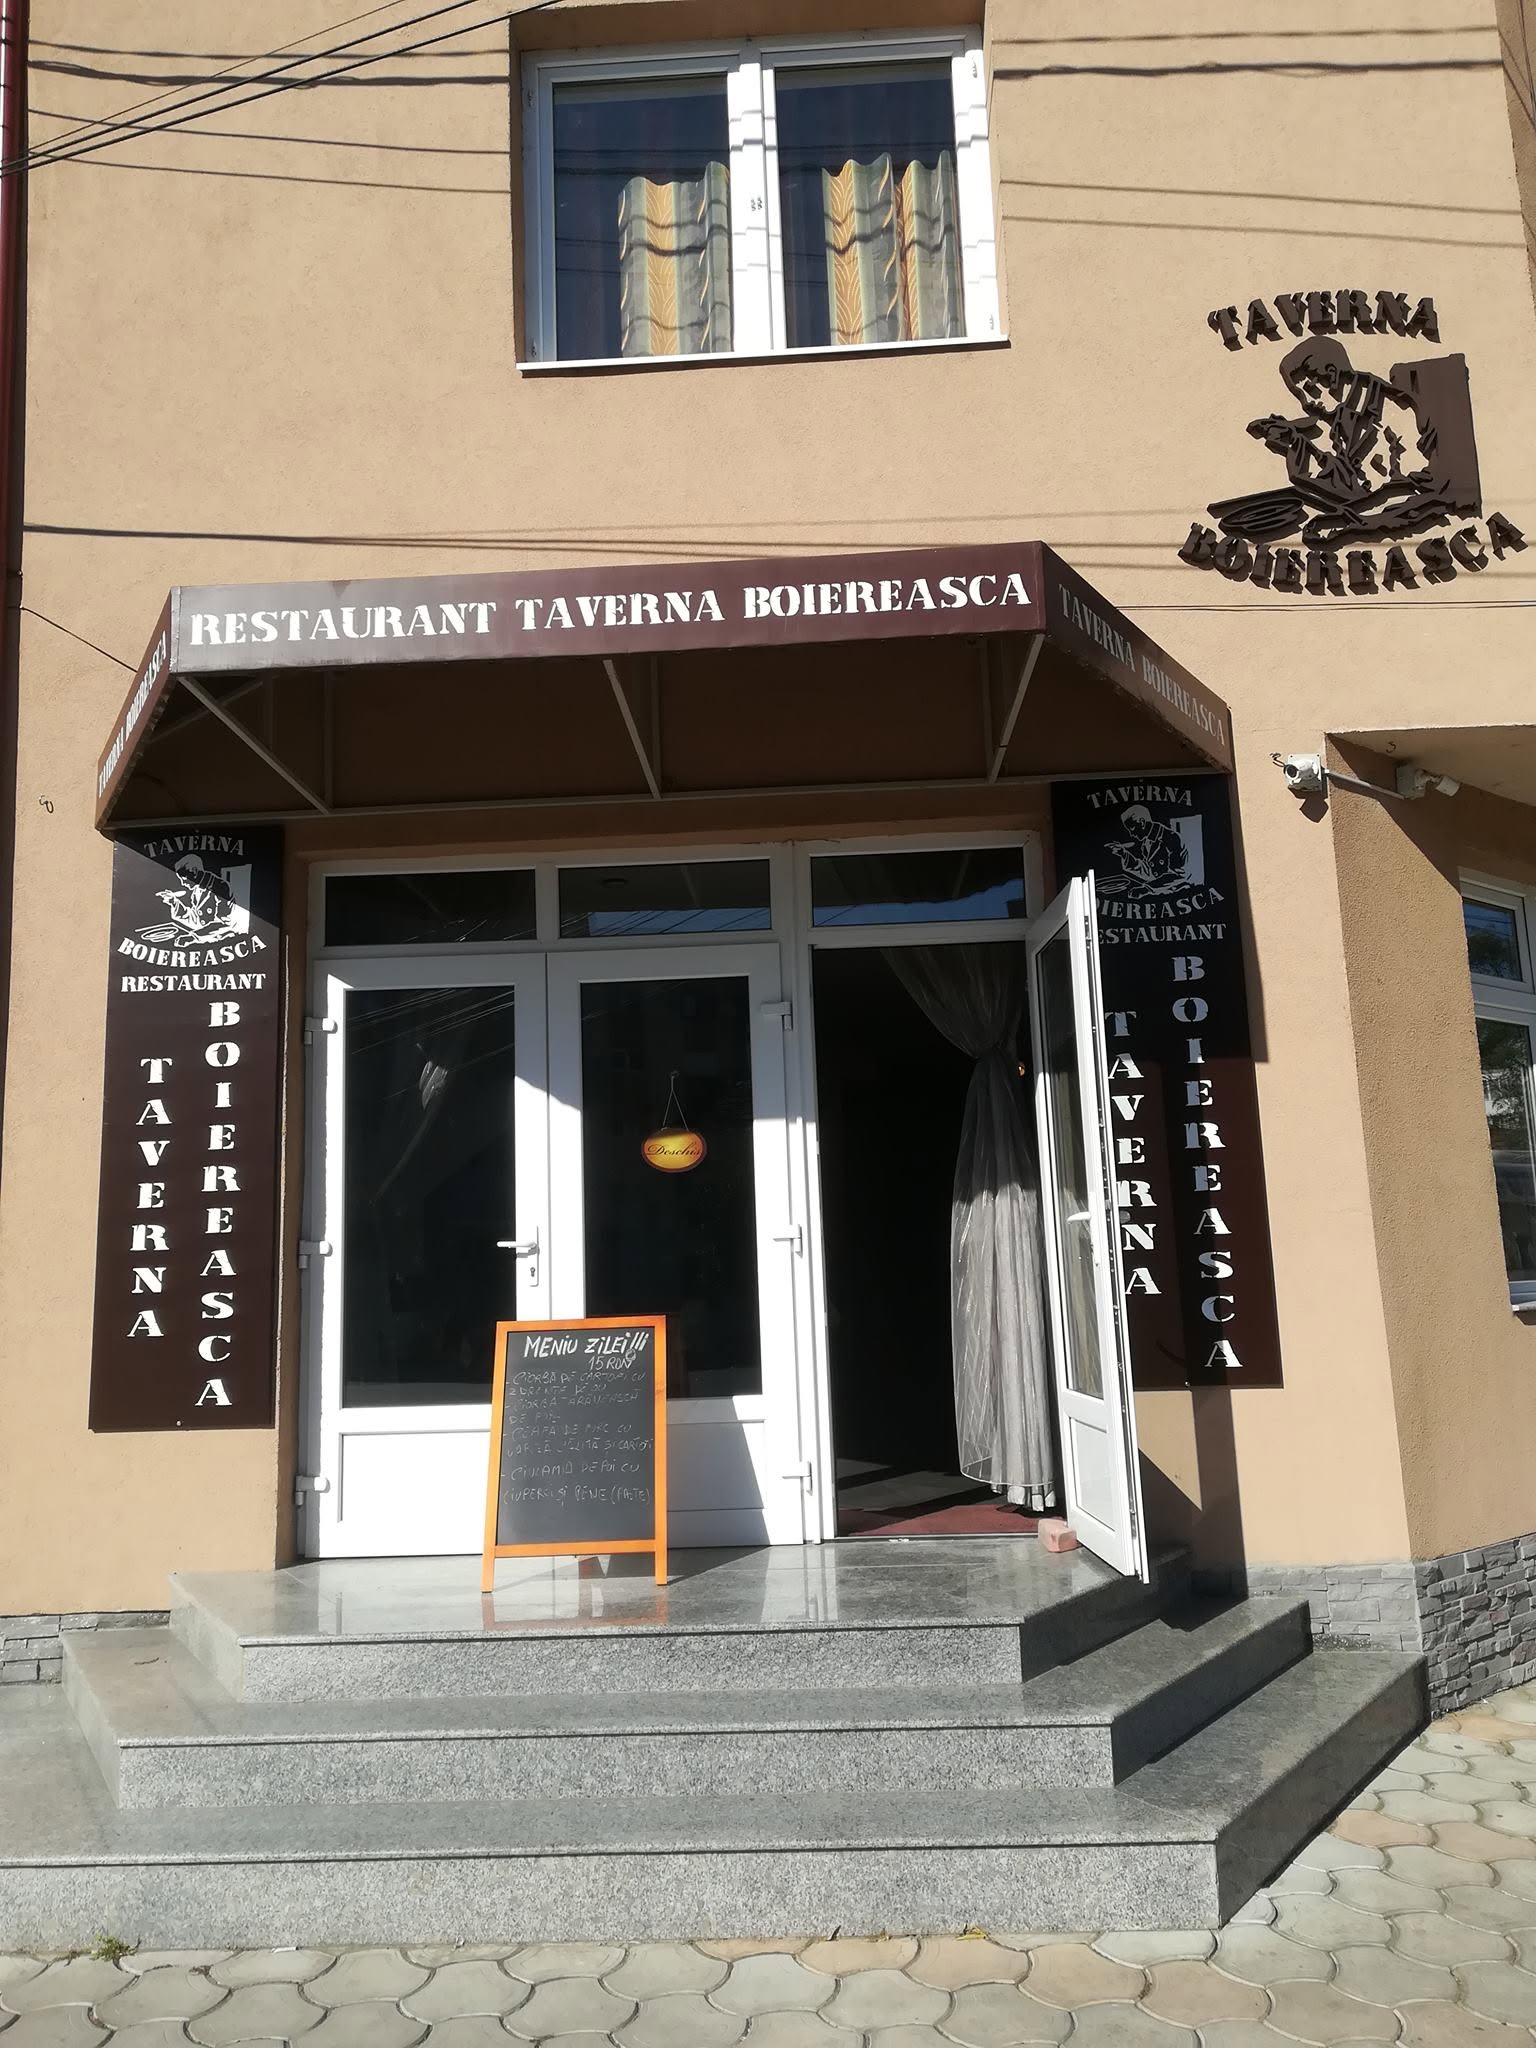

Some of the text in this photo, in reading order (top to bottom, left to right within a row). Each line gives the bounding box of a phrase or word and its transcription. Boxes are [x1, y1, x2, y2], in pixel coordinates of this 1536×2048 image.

[1207, 289, 1441, 351] TAVERNA
[1178, 512, 1529, 596] BOIEREASCA
[189, 573, 1031, 646] RESTAURANT TAVERNA BOIEREASCA
[1059, 584, 1225, 745] TAVERNA BOIEREASCA
[1087, 785, 1192, 808] TAVERNA
[143, 835, 246, 858] TAVERNA
[1096, 887, 1224, 919] IEREASCA
[1098, 923, 1226, 944] ESTAURANT
[117, 935, 267, 967] BOIEREASCA
[121, 973, 266, 993] RESTAURANT
[1105, 1011, 1161, 1295] TAVERNA
[1172, 956, 1243, 1368] BOIEREASCA
[126, 1058, 173, 1337] TAVERNA
[194, 1001, 241, 1406] BOIEREASCA
[588, 1356, 633, 1370] 15 RON
